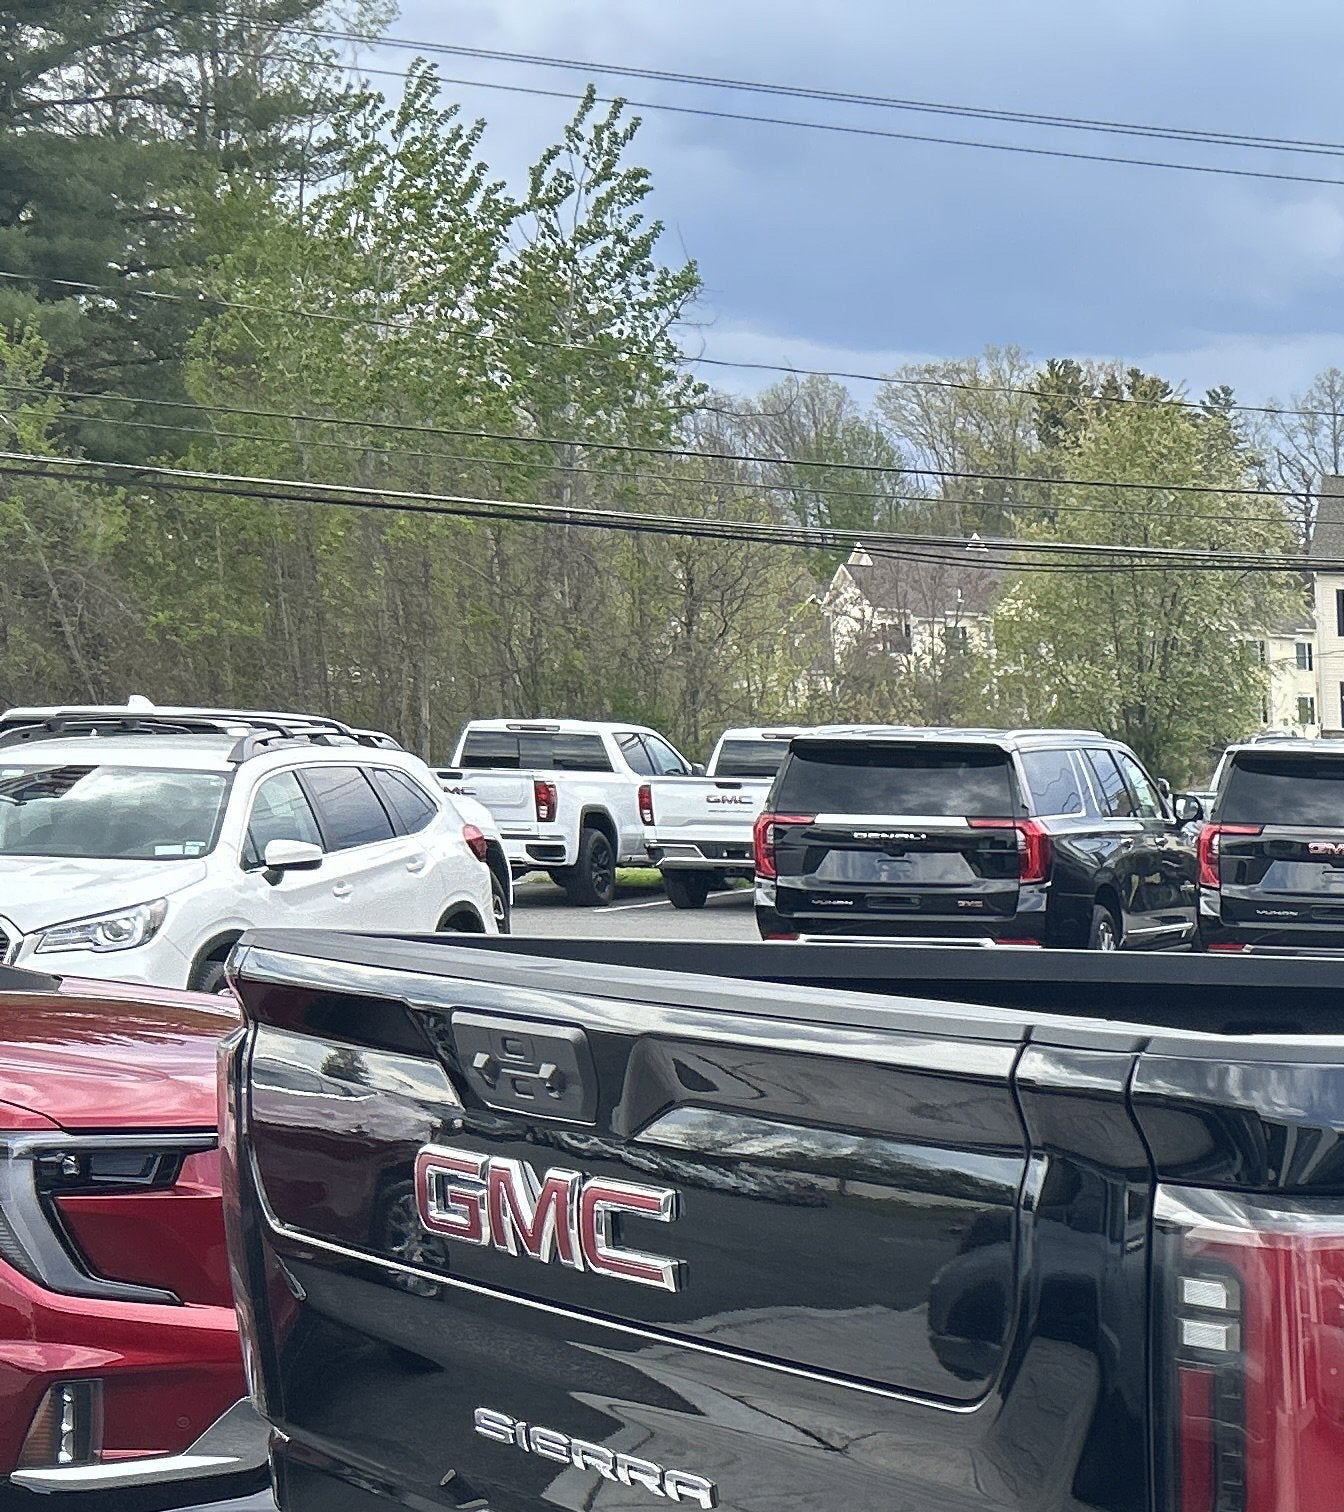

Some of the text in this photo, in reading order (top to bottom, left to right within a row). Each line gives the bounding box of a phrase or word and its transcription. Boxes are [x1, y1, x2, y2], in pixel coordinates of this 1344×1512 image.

[706, 795, 753, 804] GMC
[414, 1143, 681, 1293] GMC
[474, 1407, 719, 1510] SIERRA
